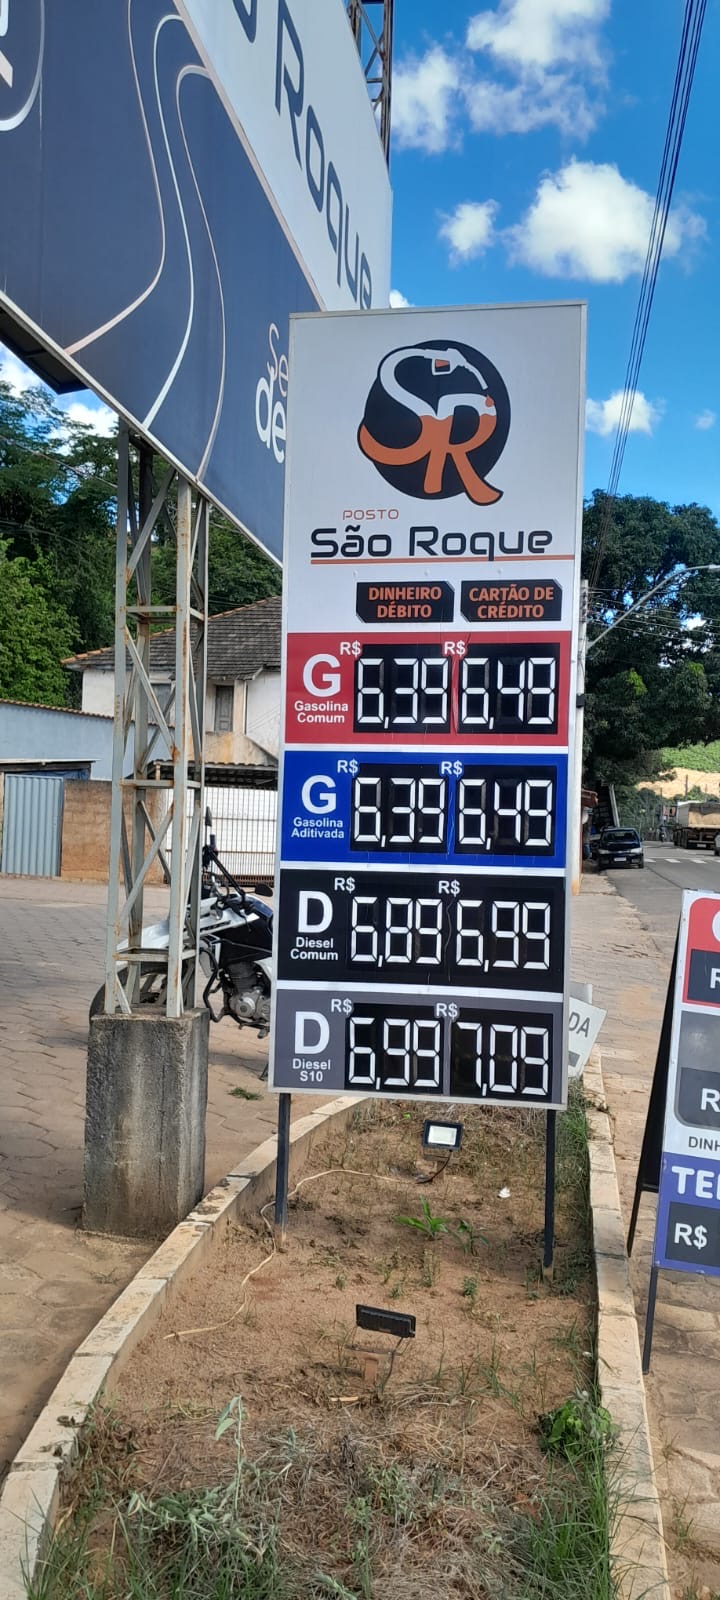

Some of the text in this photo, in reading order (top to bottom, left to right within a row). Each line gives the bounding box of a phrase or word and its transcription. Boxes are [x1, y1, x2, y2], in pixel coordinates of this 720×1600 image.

[275, 0, 371, 310] Roque
[342, 509, 399, 521] POSTO
[310, 525, 553, 561] São Roque
[368, 586, 442, 601] DINHEIRO
[469, 584, 554, 601] CARTÃO DE
[377, 602, 432, 619] DÉBITO
[477, 602, 545, 619] CRÉDITO
[303, 653, 341, 697] G
[340, 640, 448, 729] R$ 6,39
[444, 640, 556, 730] R$ 6,49
[294, 701, 348, 714] Gasolina
[297, 713, 345, 723] Comum
[301, 775, 337, 814] G
[337, 759, 446, 847] R$ 6,39
[441, 760, 553, 850] R$ 6,49
[291, 828, 345, 839] Aditivada
[293, 817, 343, 828] Gasolina
[298, 891, 333, 933] D
[334, 877, 443, 968] R$ 6,89
[438, 880, 551, 973] R$ 6,99
[290, 949, 338, 961] Comum
[296, 937, 334, 948] Diesel
[294, 1011, 330, 1054] D
[331, 999, 441, 1090] R$ 6,99
[436, 1003, 549, 1096] R$ 7,09
[292, 1059, 331, 1070] Diesel
[300, 1070, 323, 1082] S10
[671, 1165, 720, 1200] TE
[674, 1222, 708, 1250] R$
